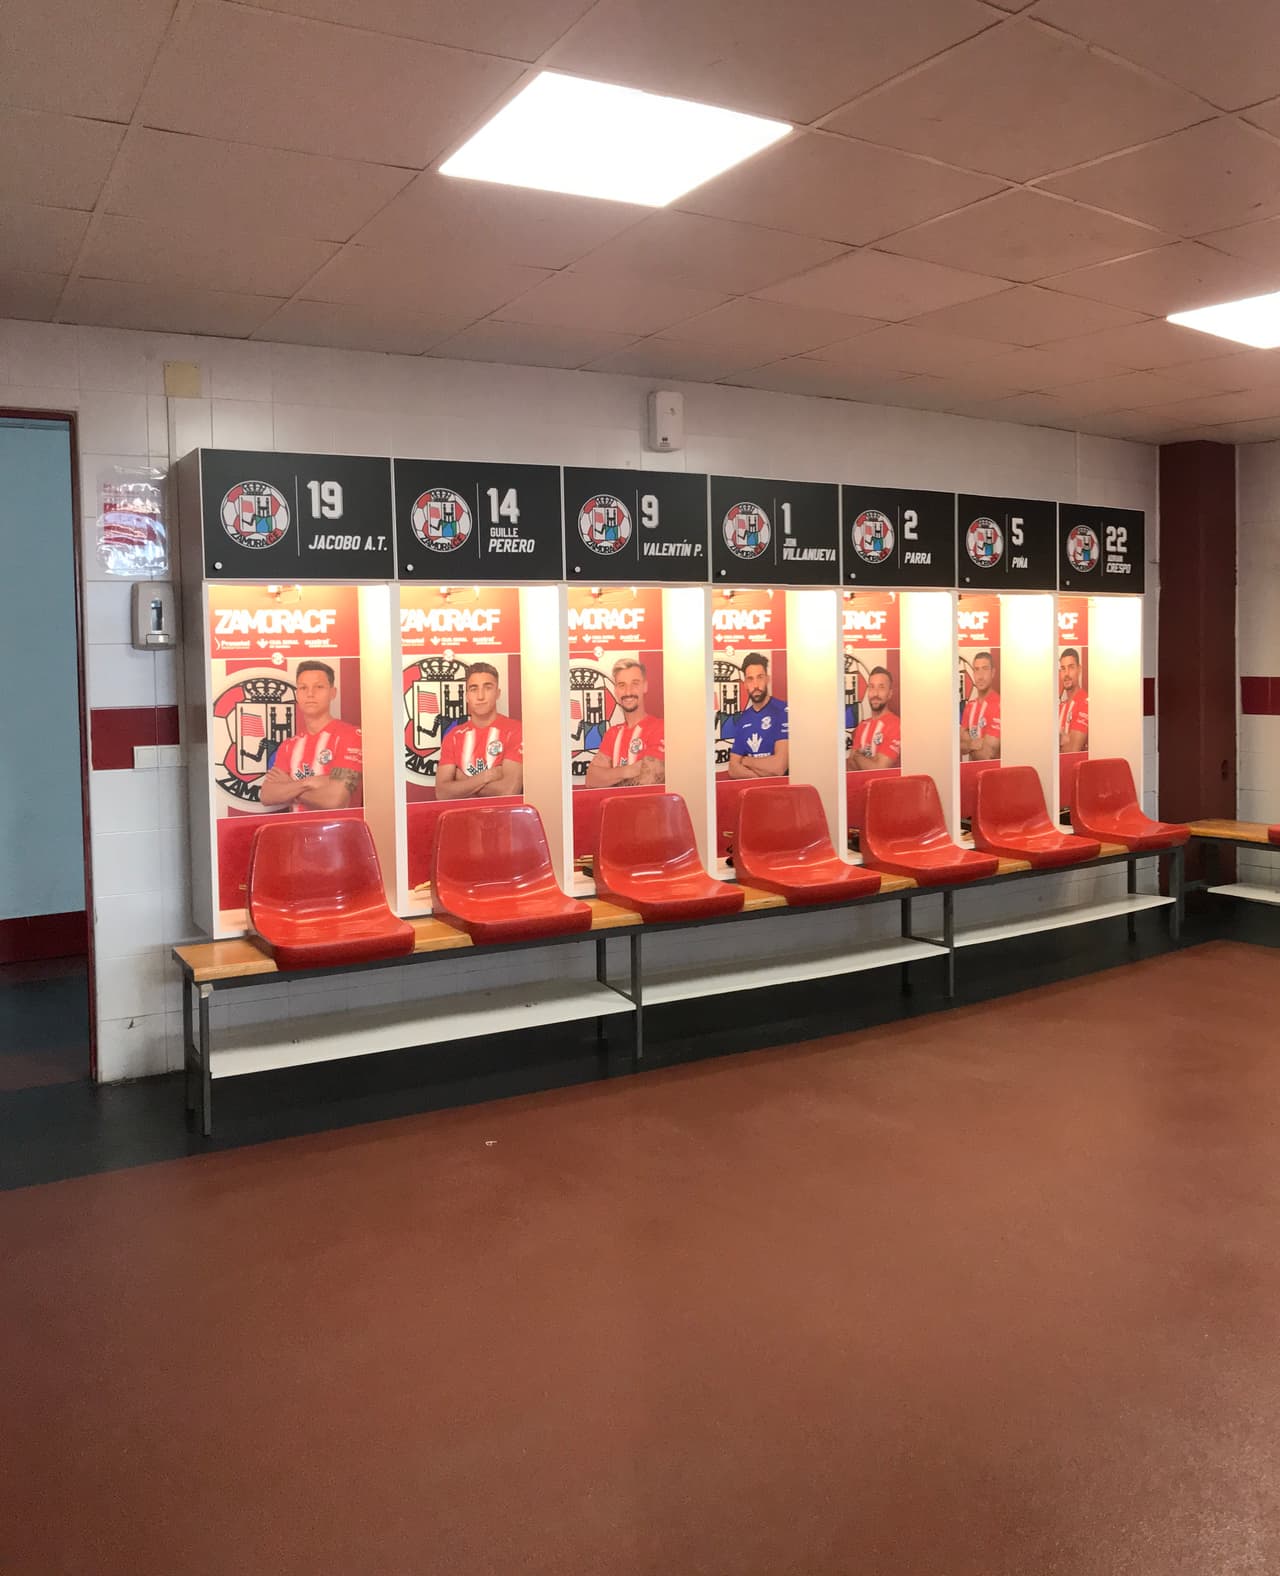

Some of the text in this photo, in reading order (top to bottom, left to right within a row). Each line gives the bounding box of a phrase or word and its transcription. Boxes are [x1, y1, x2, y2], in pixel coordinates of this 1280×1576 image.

[307, 481, 343, 519] 19
[487, 488, 520, 524] 14
[642, 495, 659, 528] 9
[781, 503, 791, 534] 1
[904, 510, 918, 540] 2
[308, 535, 387, 551] JACOBO A.T.
[490, 527, 519, 537] GUILLE
[1012, 518, 1023, 546] 5
[1106, 526, 1127, 553] 22
[488, 539, 535, 553] PERERO
[644, 539, 703, 556] VALENTÍN P.
[783, 548, 836, 561] VILLANUEVA
[904, 552, 931, 564] PARRA
[1106, 563, 1131, 574] CRESPO
[215, 609, 336, 634] ZAMORACF
